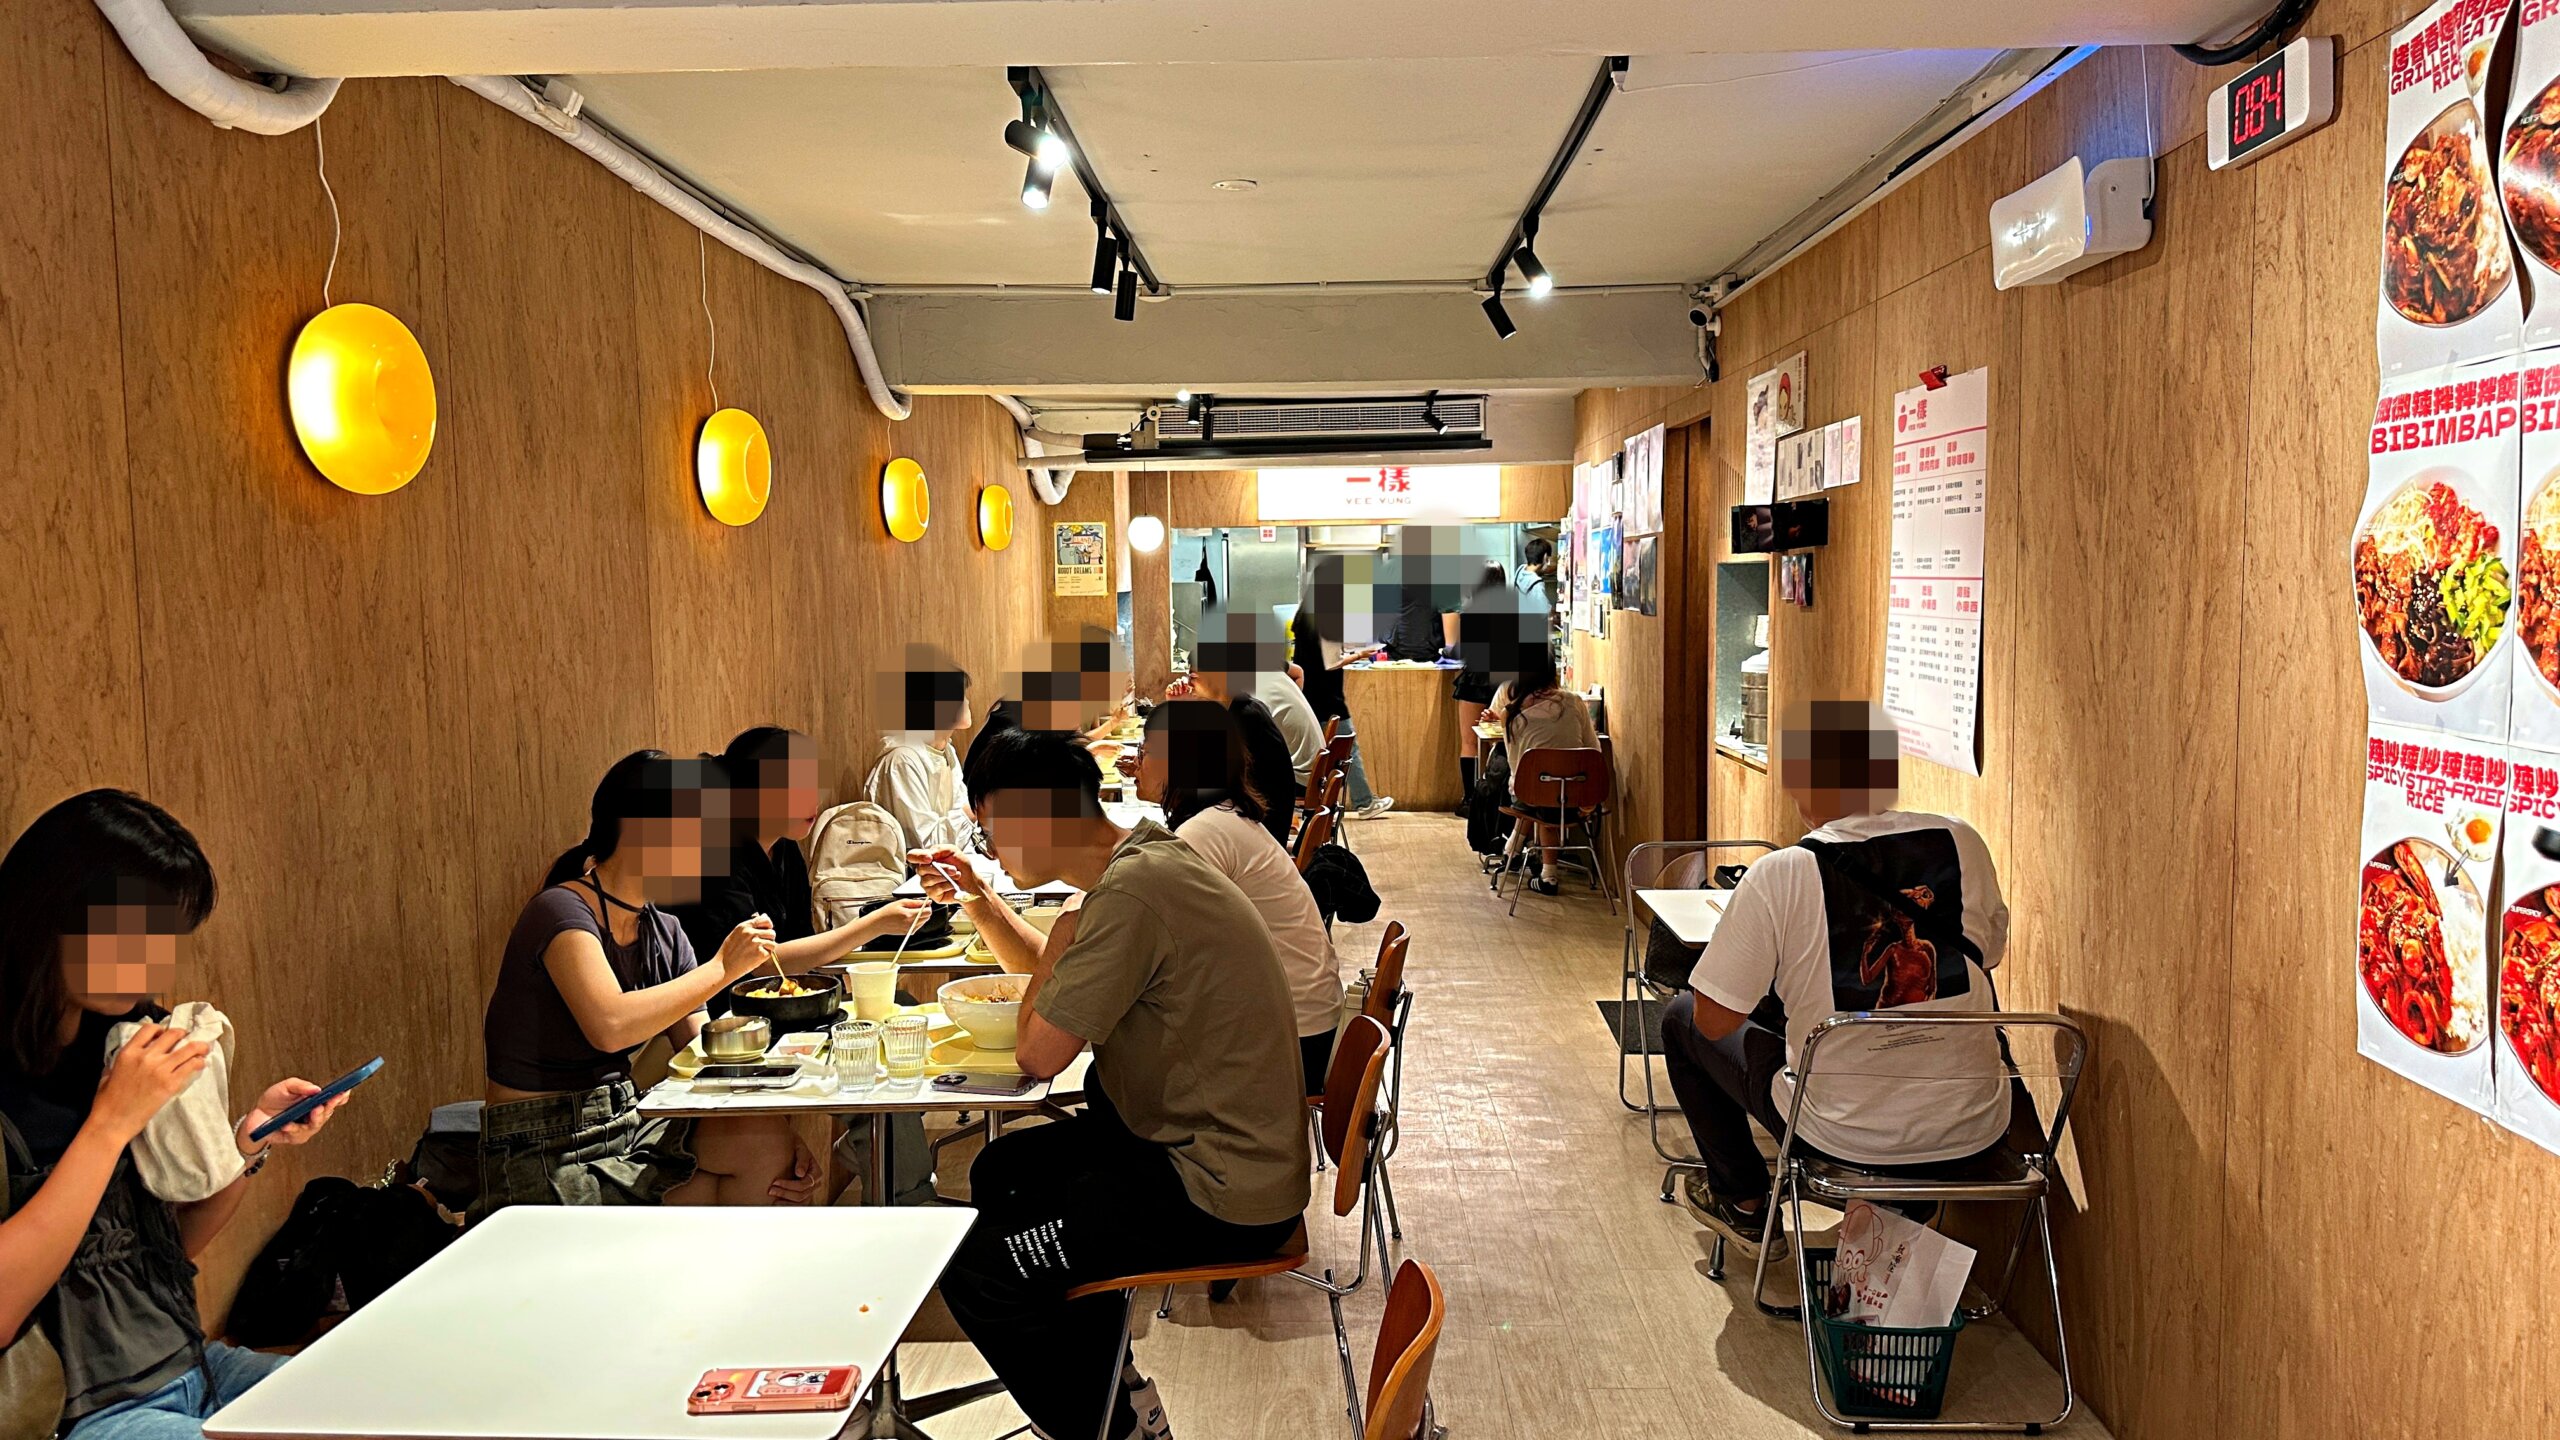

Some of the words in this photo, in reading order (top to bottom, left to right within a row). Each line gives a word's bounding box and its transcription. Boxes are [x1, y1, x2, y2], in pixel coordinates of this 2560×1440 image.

[2234, 68, 2282, 145] 084
[2371, 406, 2517, 454] BIBIMBAP
[1346, 466, 1411, 492] 一樣
[2368, 764, 2406, 786] SPICY
[2406, 790, 2445, 815] RICE
[1030, 1227, 1045, 1254] yourself
[1040, 1225, 1050, 1243] Treat
[1055, 1241, 1061, 1250] no
[1012, 1252, 1021, 1266] own
